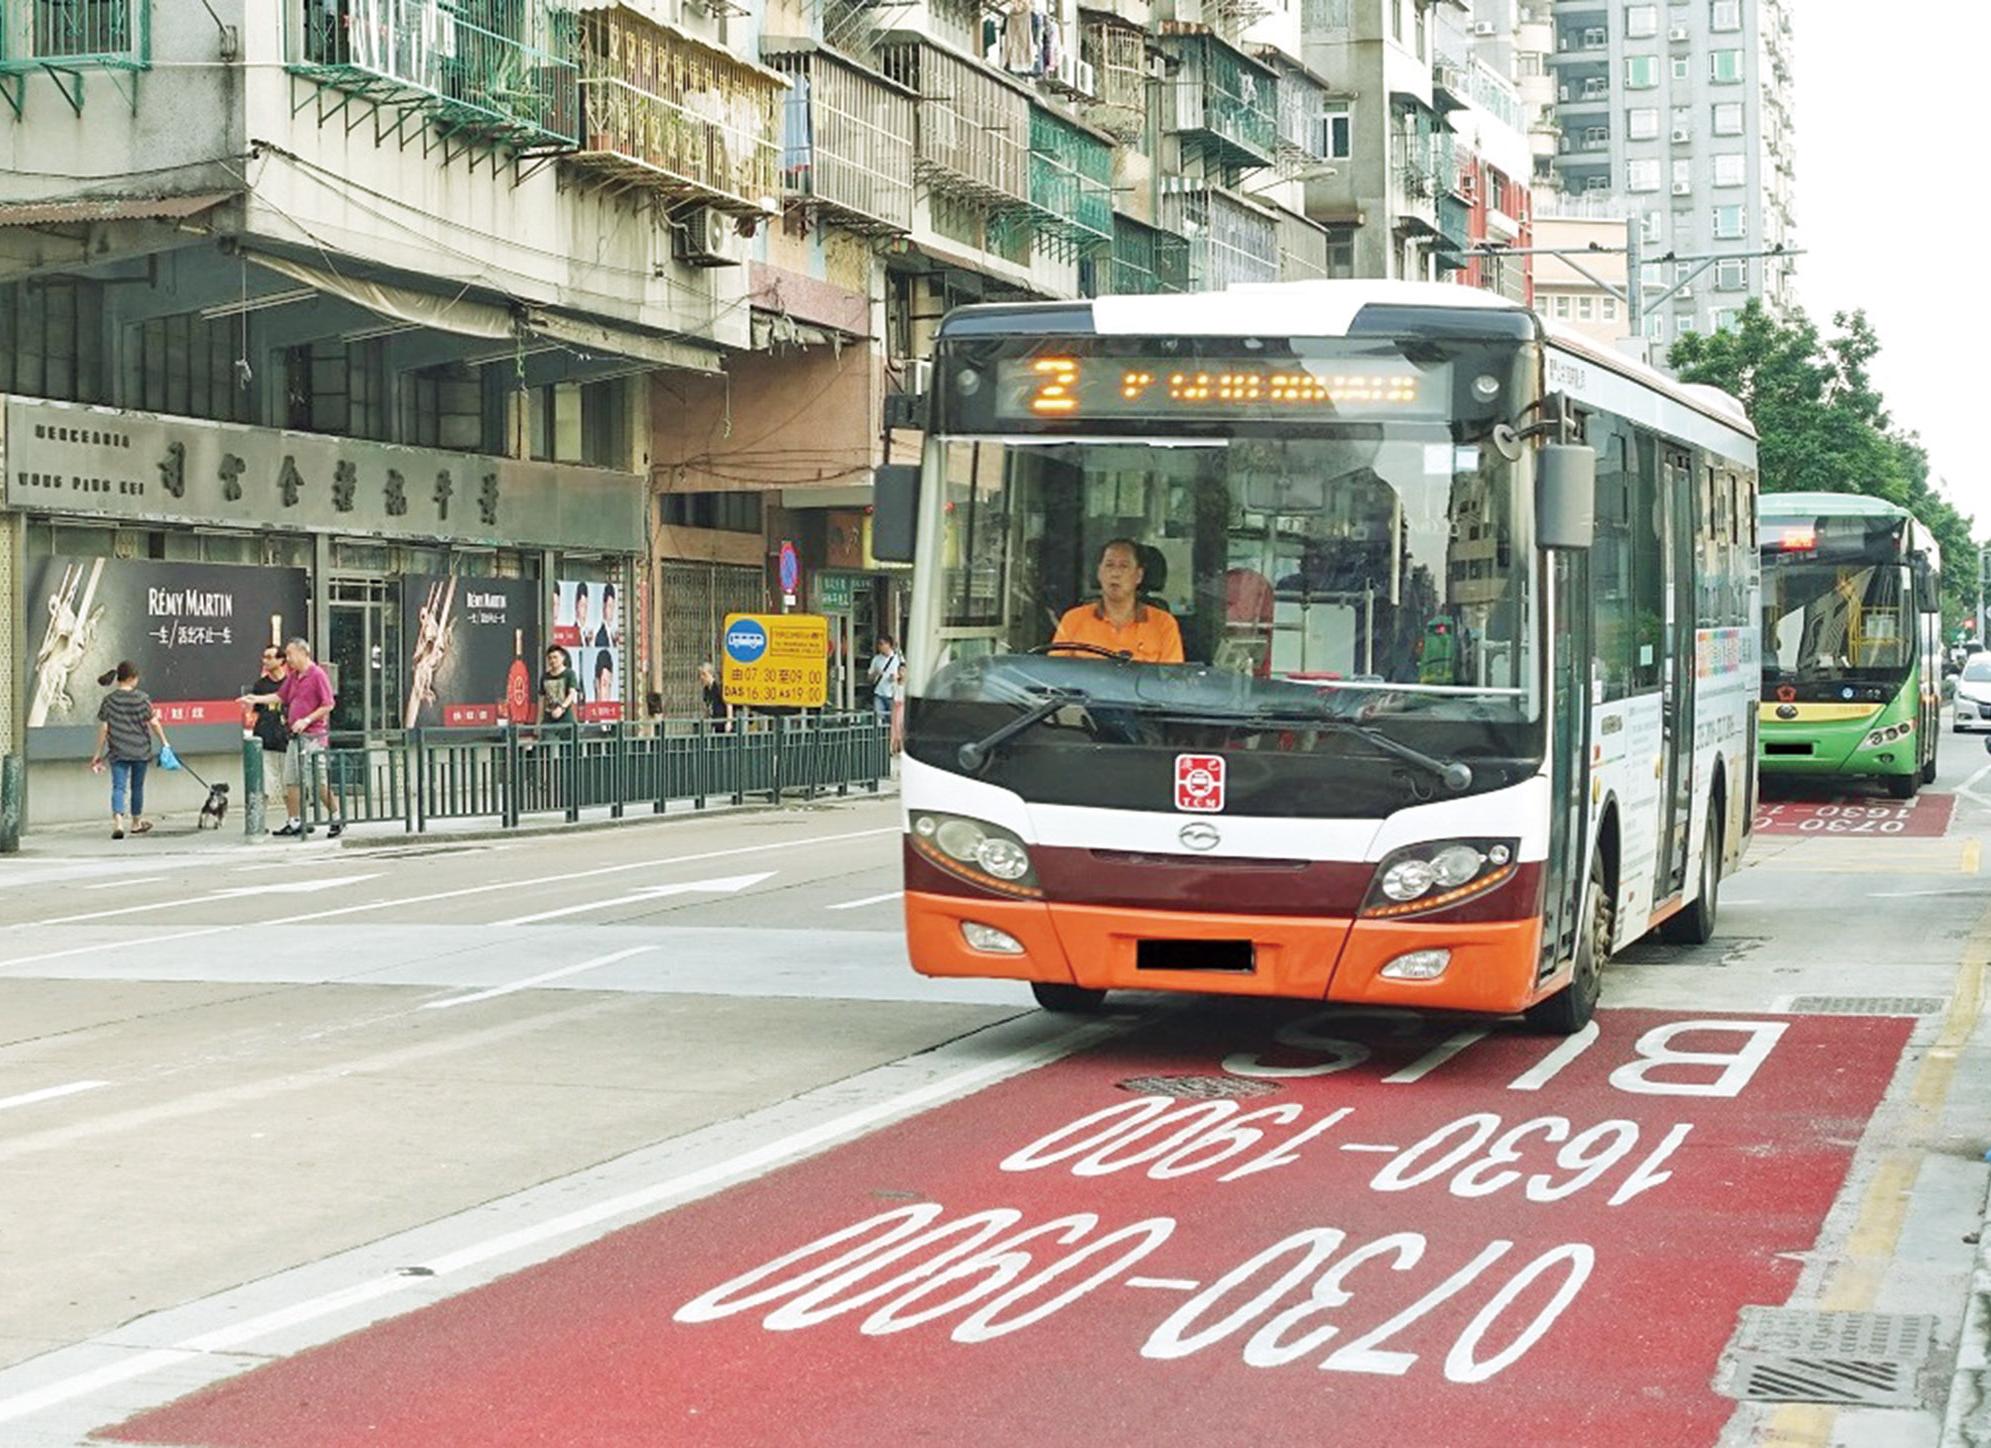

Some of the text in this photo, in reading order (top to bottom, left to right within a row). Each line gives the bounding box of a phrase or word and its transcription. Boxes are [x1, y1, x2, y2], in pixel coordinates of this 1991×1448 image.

[1032, 360, 1079, 411] 2
[186, 589, 232, 617] MARTIN
[1000, 1095, 1693, 1206] 1630-1900
[673, 1202, 1596, 1383] 0730-0900
